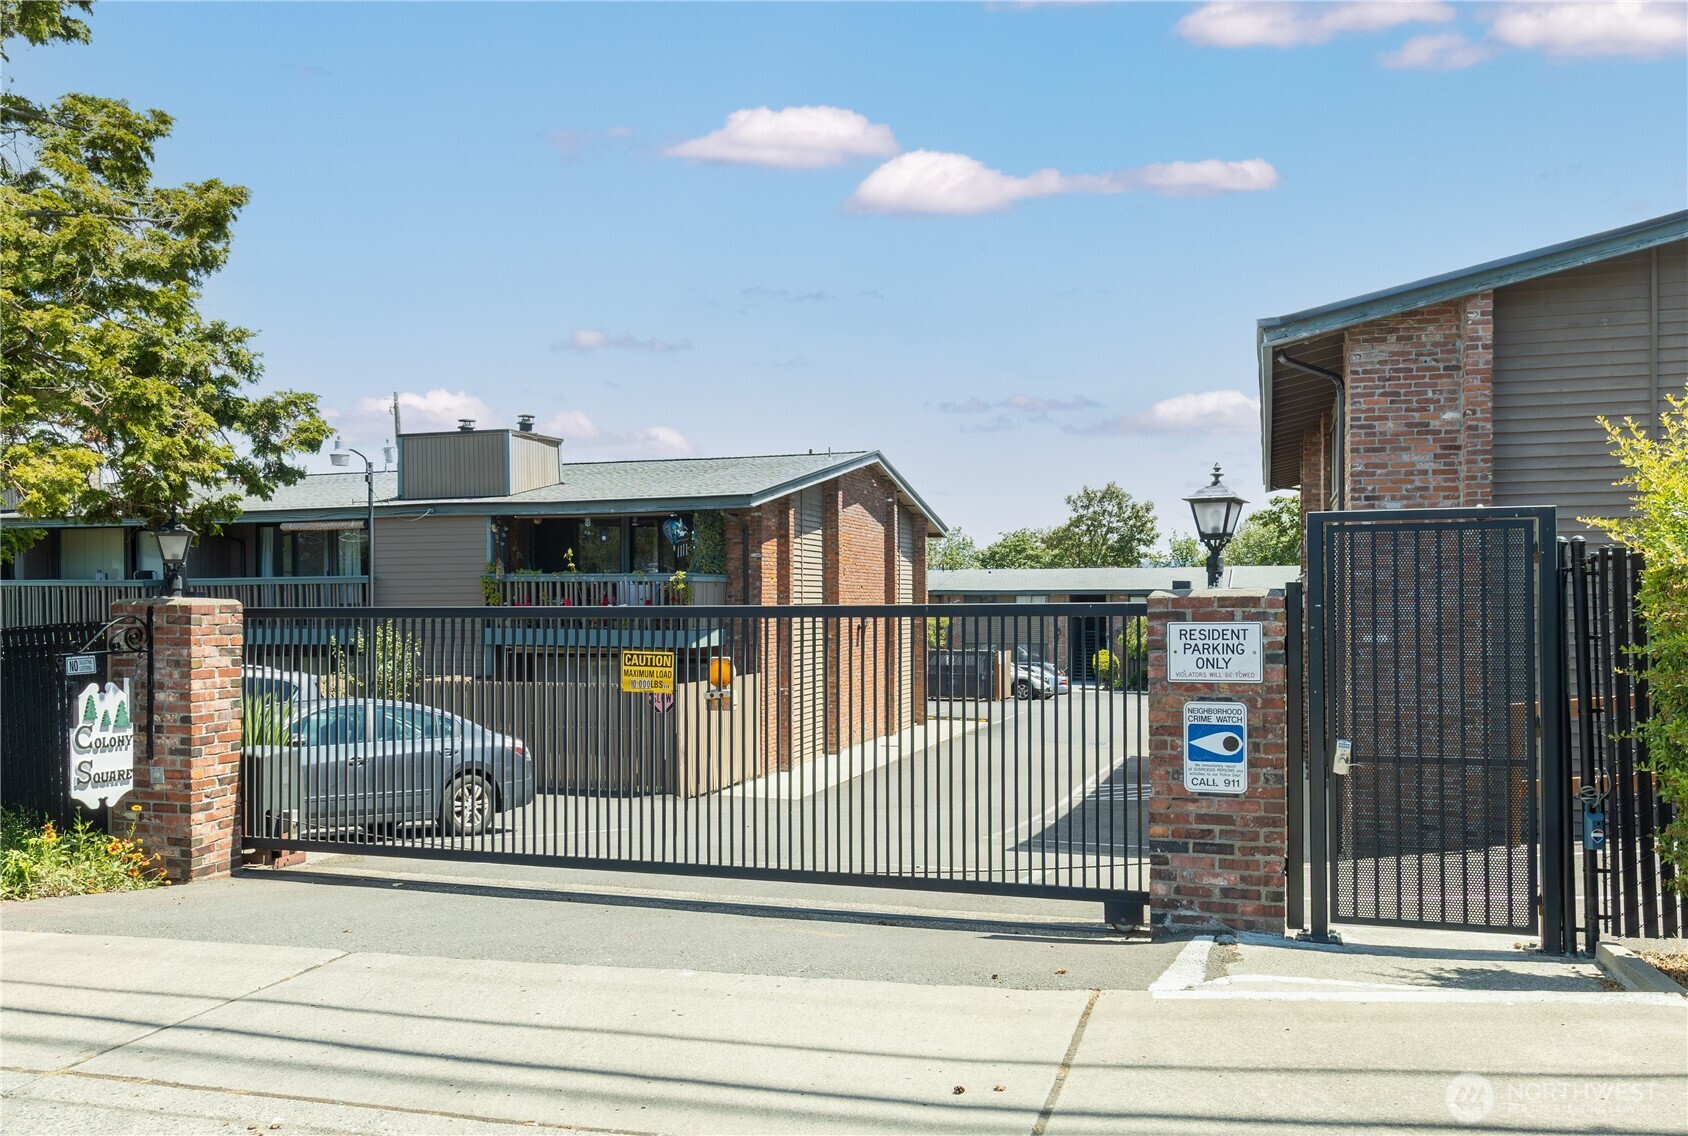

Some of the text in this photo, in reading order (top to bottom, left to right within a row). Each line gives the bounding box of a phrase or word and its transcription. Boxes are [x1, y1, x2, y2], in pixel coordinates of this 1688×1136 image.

[1179, 628, 1249, 641] RESIDENT
[1183, 643, 1245, 655] PARKING
[69, 660, 79, 672] NO
[625, 654, 671, 667] CAUTION
[1195, 657, 1232, 669] ONLY
[623, 669, 672, 679] MAXIMUM LOAD
[1187, 707, 1243, 715] NEIGHBORHOOD
[1187, 715, 1243, 723] CRIME WATCH
[1191, 777, 1240, 788] CALL 911
